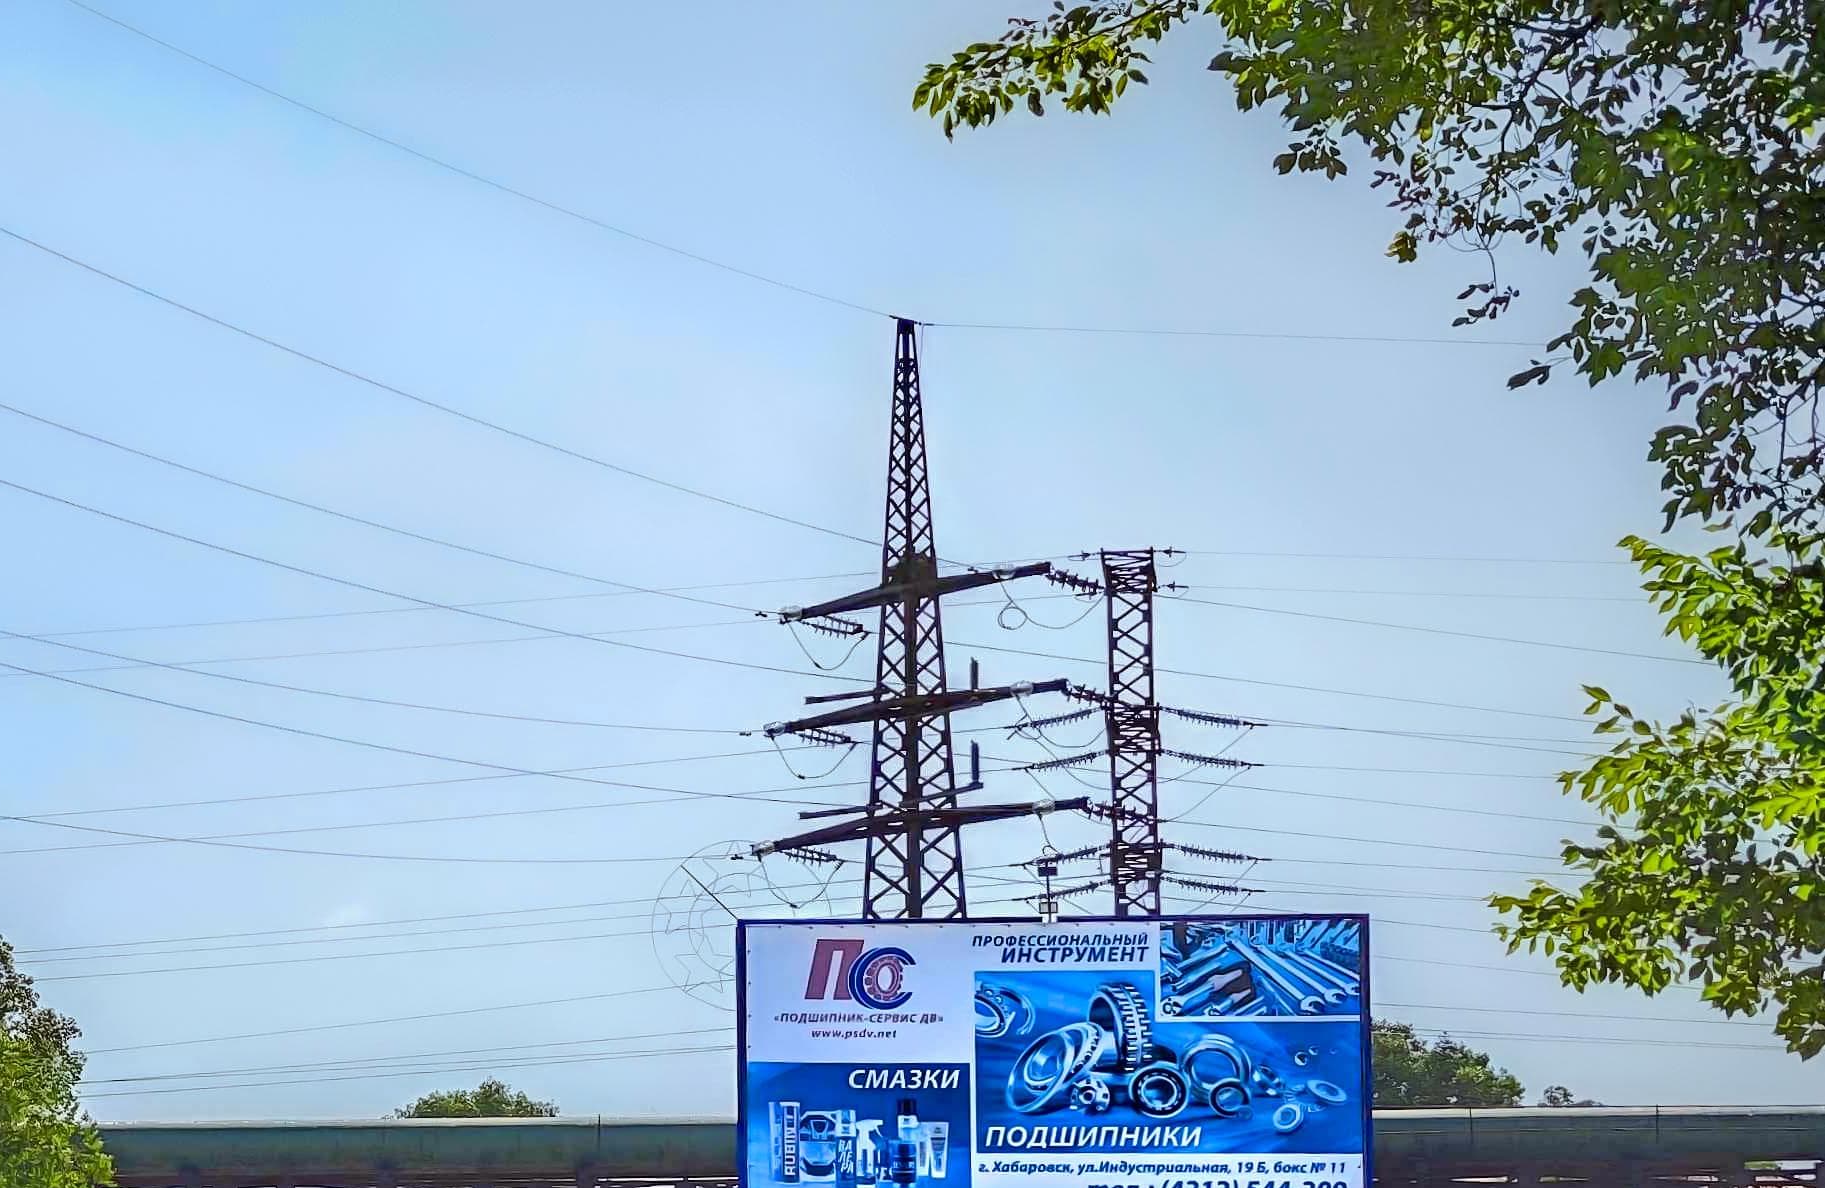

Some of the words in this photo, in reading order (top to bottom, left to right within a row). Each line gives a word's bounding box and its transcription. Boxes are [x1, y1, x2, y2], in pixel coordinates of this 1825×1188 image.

[972, 932, 1149, 947] ПРОФЕССИОНАЛЬНЫЙ
[1001, 946, 1150, 963] ИНСТРУМЕНТ
[811, 1028, 897, 1039] www.psdv.net
[848, 1069, 961, 1089] СМАЗКИ
[985, 1126, 1202, 1149] ПОДШИПНИКИ
[978, 1164, 990, 1173] г.
[992, 1161, 1075, 1174] Хабаровск,
[1237, 1162, 1254, 1173] 19
[1273, 1161, 1307, 1173] бокс
[1310, 1162, 1326, 1173] №
[1331, 1162, 1345, 1173] 11
